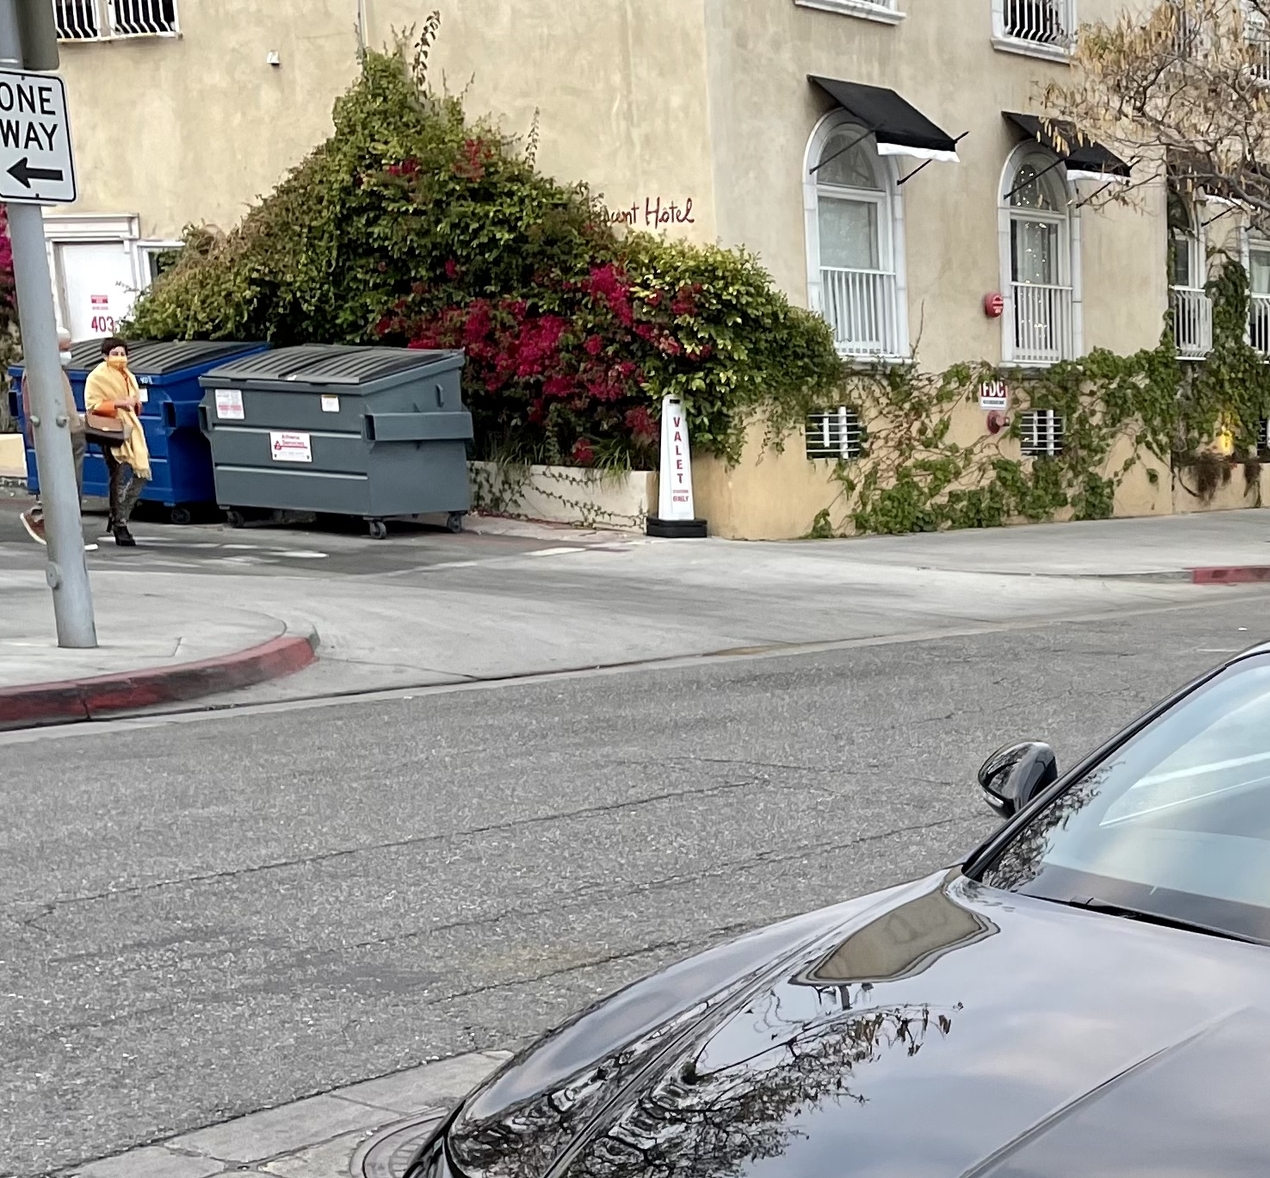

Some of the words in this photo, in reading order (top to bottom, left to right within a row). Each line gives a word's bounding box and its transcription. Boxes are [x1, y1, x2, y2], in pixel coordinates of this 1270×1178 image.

[0, 82, 56, 116] ONE
[0, 119, 58, 151] WAY
[645, 196, 695, 229] Hôtel
[983, 380, 1004, 397] FDC
[673, 417, 684, 484] VALET
